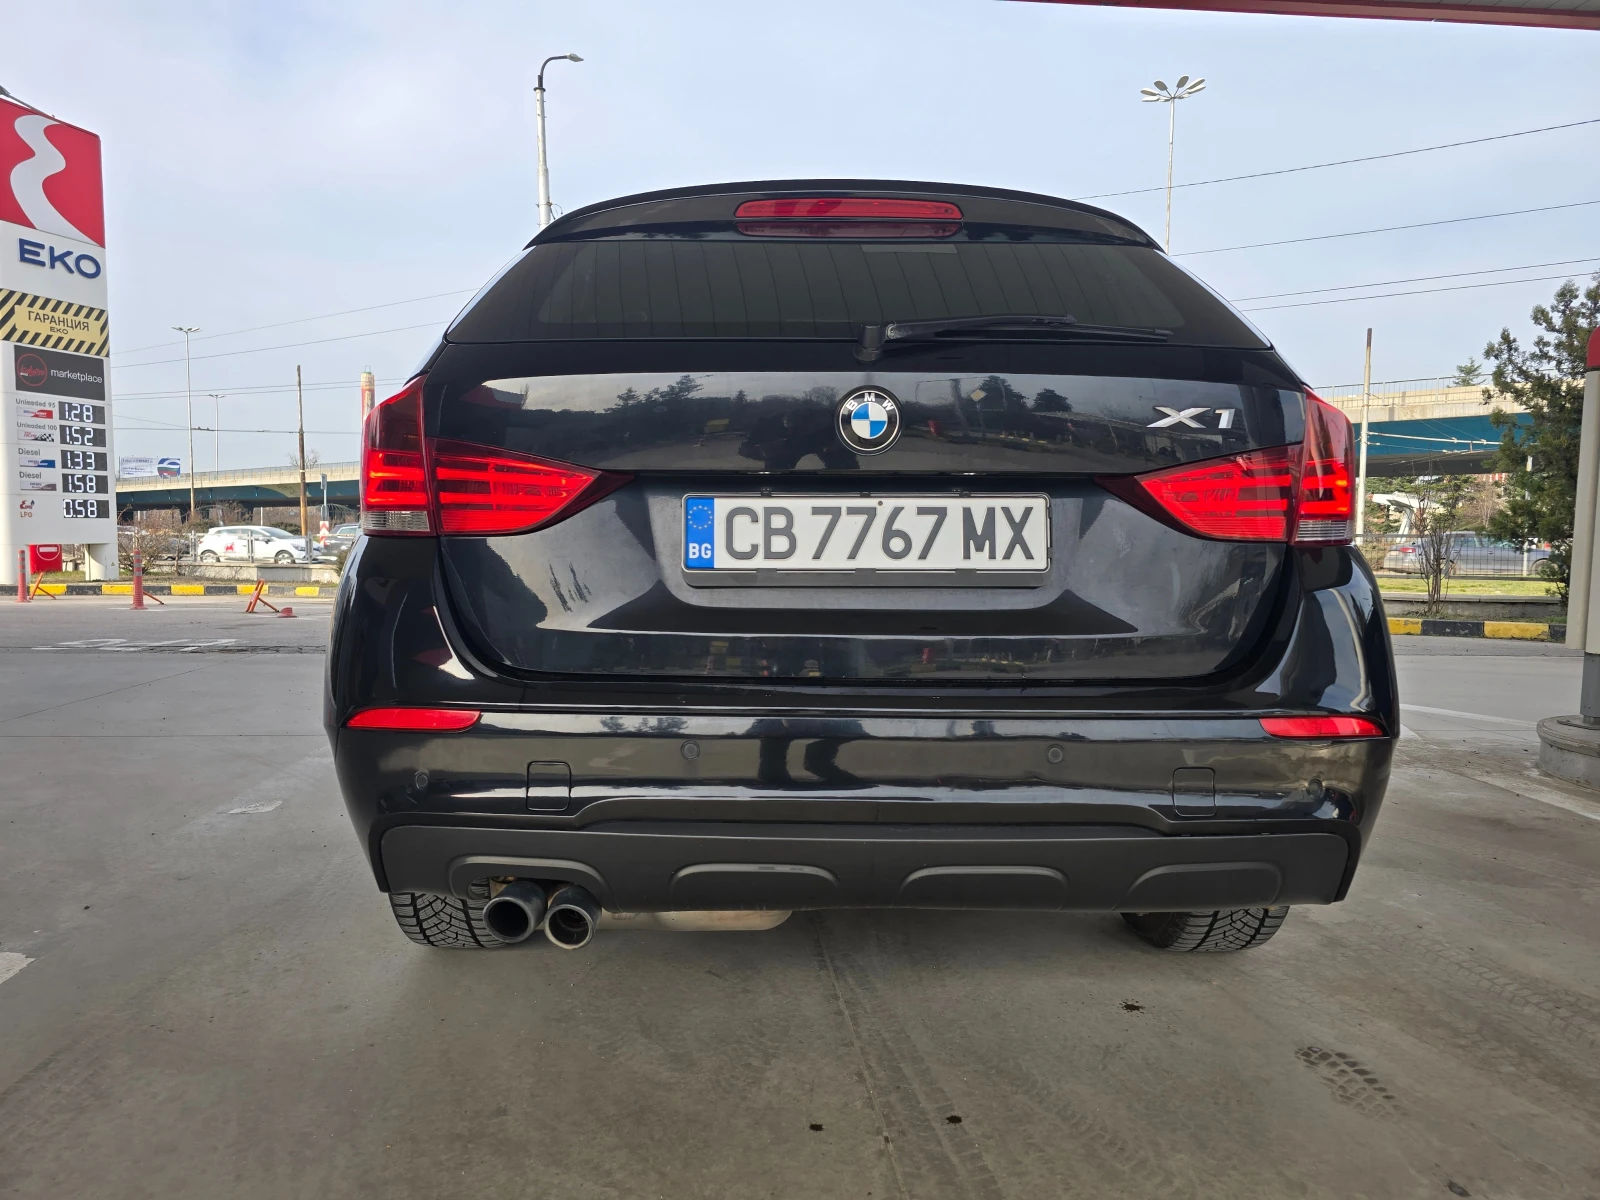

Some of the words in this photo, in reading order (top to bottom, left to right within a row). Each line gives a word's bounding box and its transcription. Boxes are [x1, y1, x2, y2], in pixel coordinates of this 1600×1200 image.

[18, 237, 101, 279] EKO
[28, 310, 89, 332] ГАРАНЦИЯ
[49, 326, 69, 335] EKO
[50, 369, 103, 384] marketplace
[15, 398, 46, 407] Unleaded
[846, 391, 895, 412] BMW
[65, 403, 93, 423] 1.28
[1146, 406, 1236, 430] X1
[16, 421, 46, 430] Unleaded
[66, 426, 94, 446] 1.52
[18, 448, 41, 456] Diesel
[67, 451, 95, 470] 1.33
[19, 471, 42, 479] Diesel
[68, 474, 97, 493] 1.58
[63, 499, 98, 518] 0.58
[724, 506, 797, 561] CB
[811, 506, 948, 561] 7767
[961, 506, 1036, 561] MX
[689, 543, 712, 560] BG
